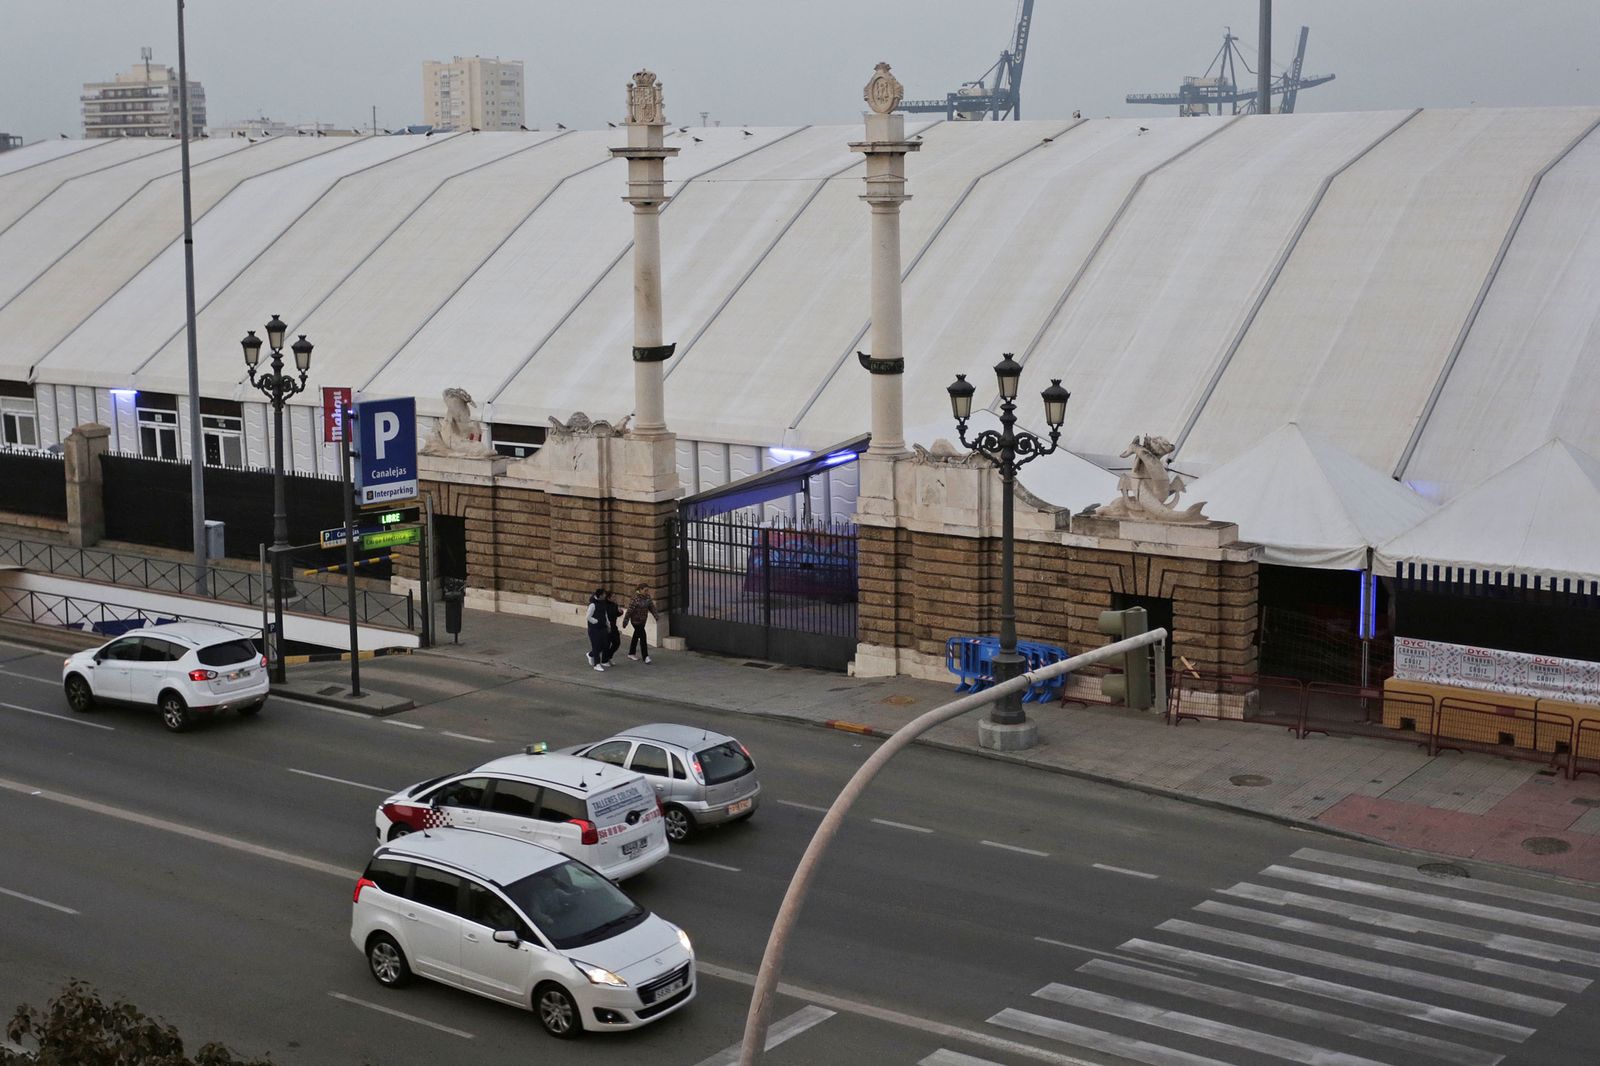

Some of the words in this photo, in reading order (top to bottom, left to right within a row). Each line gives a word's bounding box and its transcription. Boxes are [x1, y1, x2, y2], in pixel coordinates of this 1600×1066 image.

[375, 411, 400, 460] P
[371, 467, 407, 479] Canalejas
[374, 485, 414, 498] Interparking
[381, 513, 400, 524] LIBRE
[324, 532, 331, 541] P
[1403, 639, 1424, 647] DYC
[1467, 648, 1489, 656] DYC
[1535, 656, 1557, 664] DYC
[592, 795, 618, 810] TALLERES
